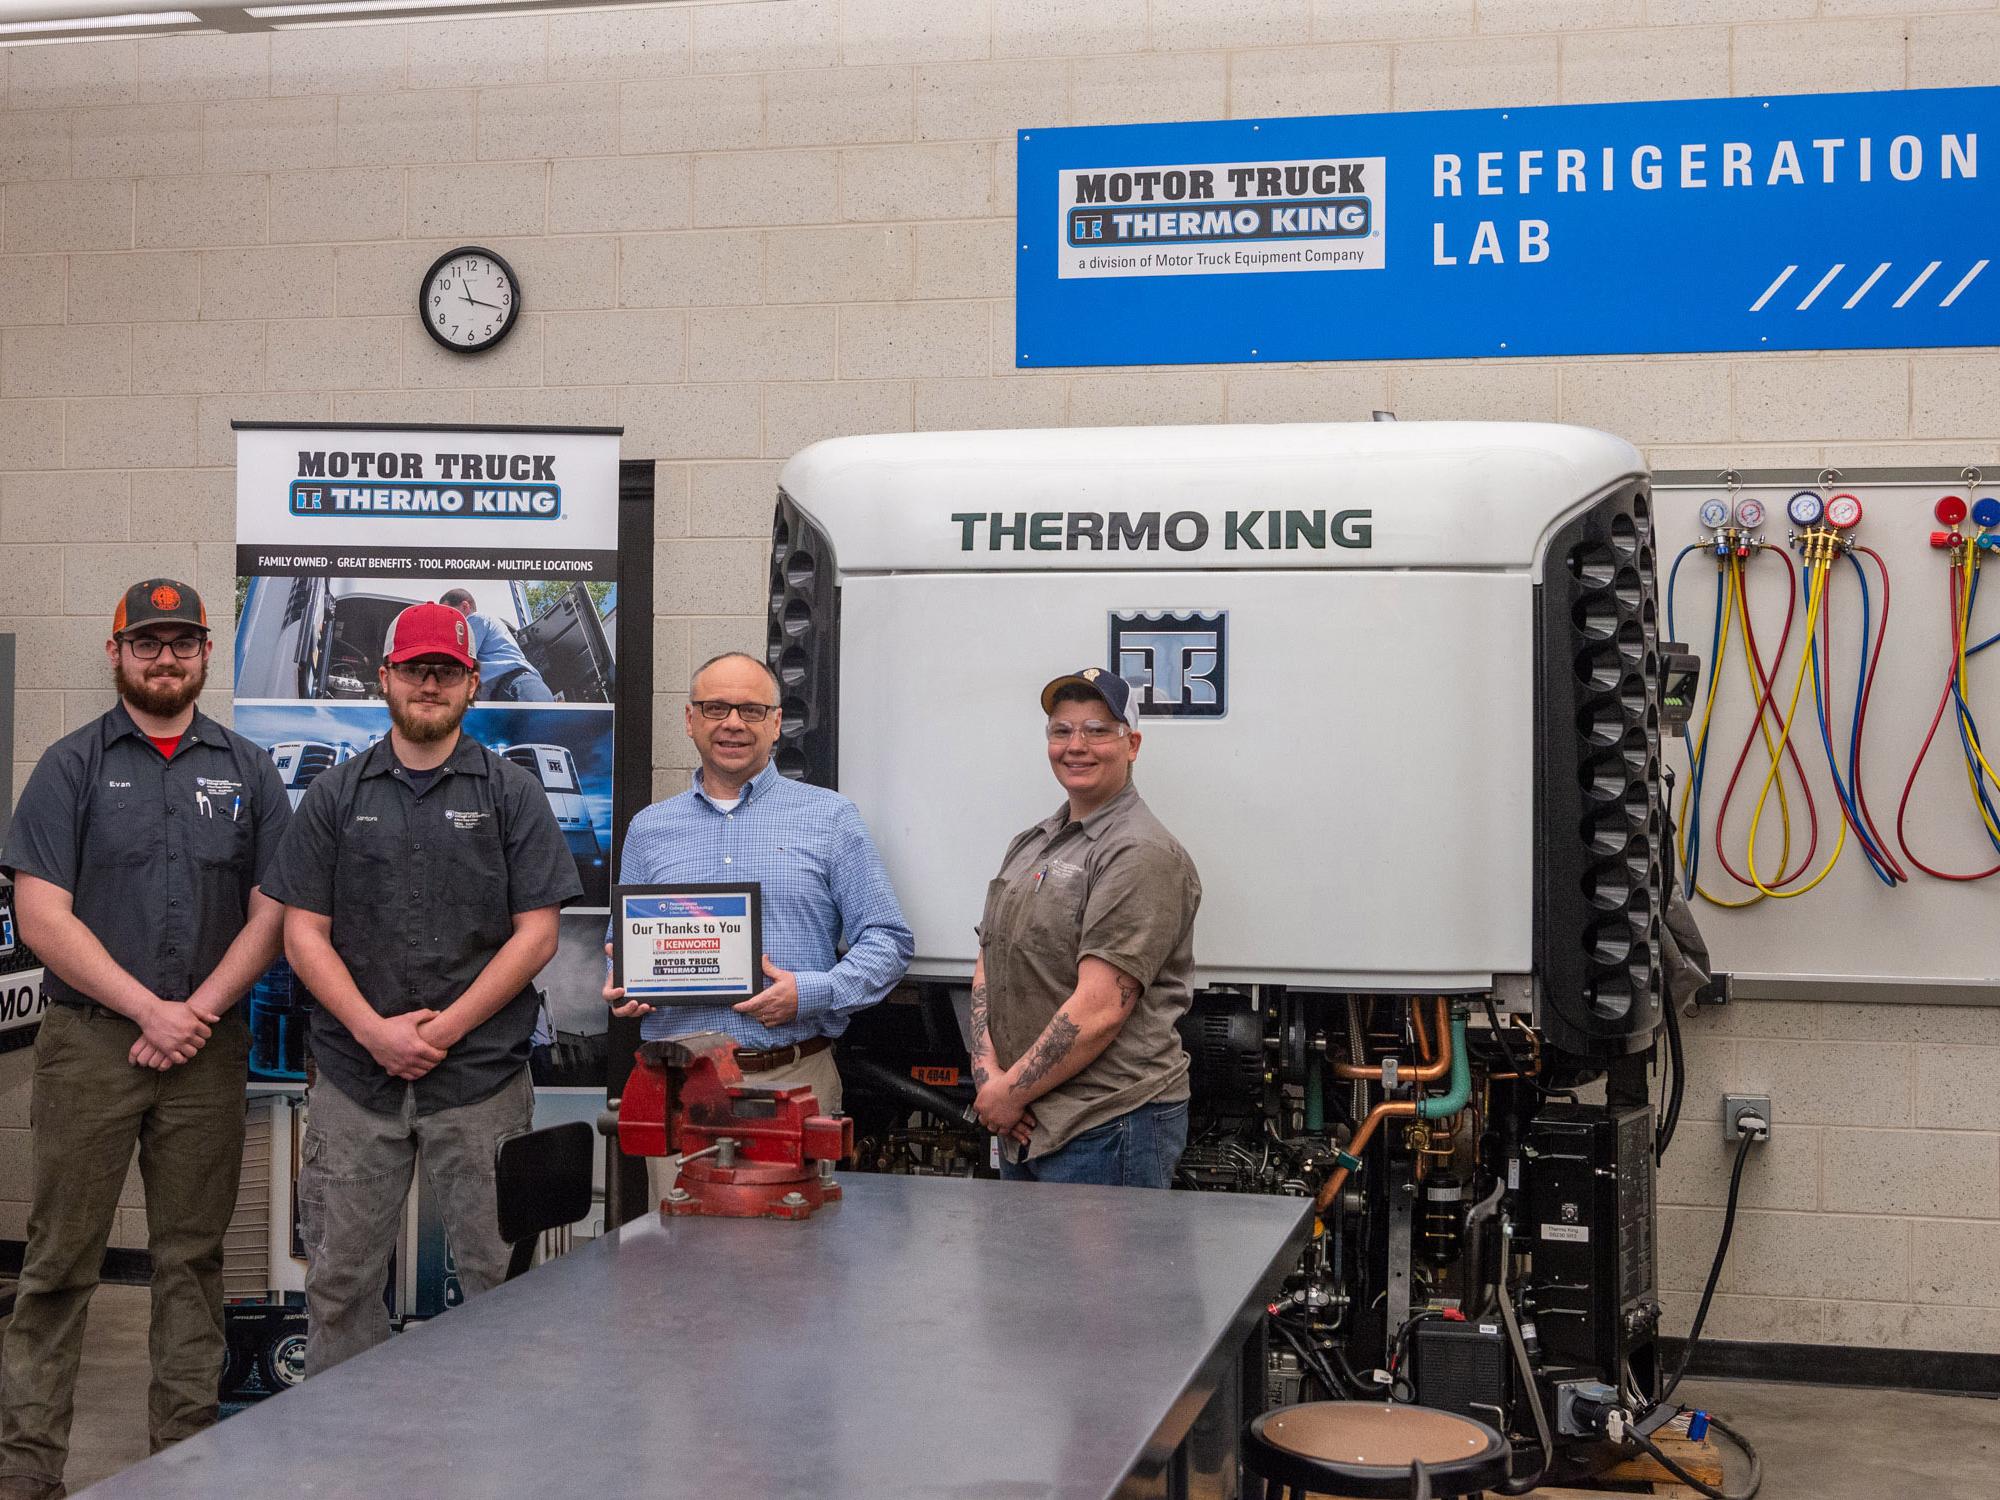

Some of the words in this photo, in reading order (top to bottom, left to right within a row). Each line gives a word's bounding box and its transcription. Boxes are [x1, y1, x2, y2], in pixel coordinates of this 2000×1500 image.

[1433, 133, 1978, 197] REFRIGERATION
[1075, 170, 1215, 203] MOTOR
[1228, 164, 1365, 197] TRUCK
[1112, 207, 1260, 238] THERMO
[1271, 205, 1366, 233] KING
[1433, 219, 1550, 266] LAB
[1079, 259, 1085, 269] a
[1090, 255, 1136, 268] division
[1140, 254, 1152, 267] of
[1156, 254, 1193, 266] Motor
[1197, 251, 1230, 265] Truck
[1235, 250, 1301, 266] Equipment
[1305, 249, 1364, 263] Company
[466, 260, 477, 271] 12
[486, 264, 490, 275] 1
[452, 267, 461, 278] 11
[440, 279, 451, 290] 10
[496, 277, 504, 288] 2
[434, 296, 441, 307] 9
[502, 294, 510, 305] 3
[439, 313, 446, 324] 8
[496, 312, 503, 323] 4
[452, 326, 459, 336] 7
[467, 330, 475, 341] 6
[484, 325, 492, 336] 5
[298, 451, 423, 478] MOTOR
[435, 454, 555, 481] TRUCK
[331, 488, 464, 512] THERMO
[472, 490, 555, 513] KING
[951, 510, 1209, 551] THERMO
[1224, 509, 1372, 549] KING
[258, 556, 292, 567] FAMILY
[293, 556, 328, 567] OWNED
[337, 557, 367, 568] GREAT
[369, 558, 412, 569] BENEFITS
[419, 558, 443, 569] TOOL
[445, 559, 490, 569] PROGRAM
[497, 560, 541, 570] MULTIPLE
[543, 561, 593, 571] LOCATIONS
[632, 923, 653, 935] Our
[656, 922, 700, 935] Thanks
[704, 923, 715, 934] to
[719, 921, 741, 933] You
[666, 940, 719, 949] KENWORTH
[655, 958, 686, 966] MOTOR
[688, 957, 719, 965] TRUCK
